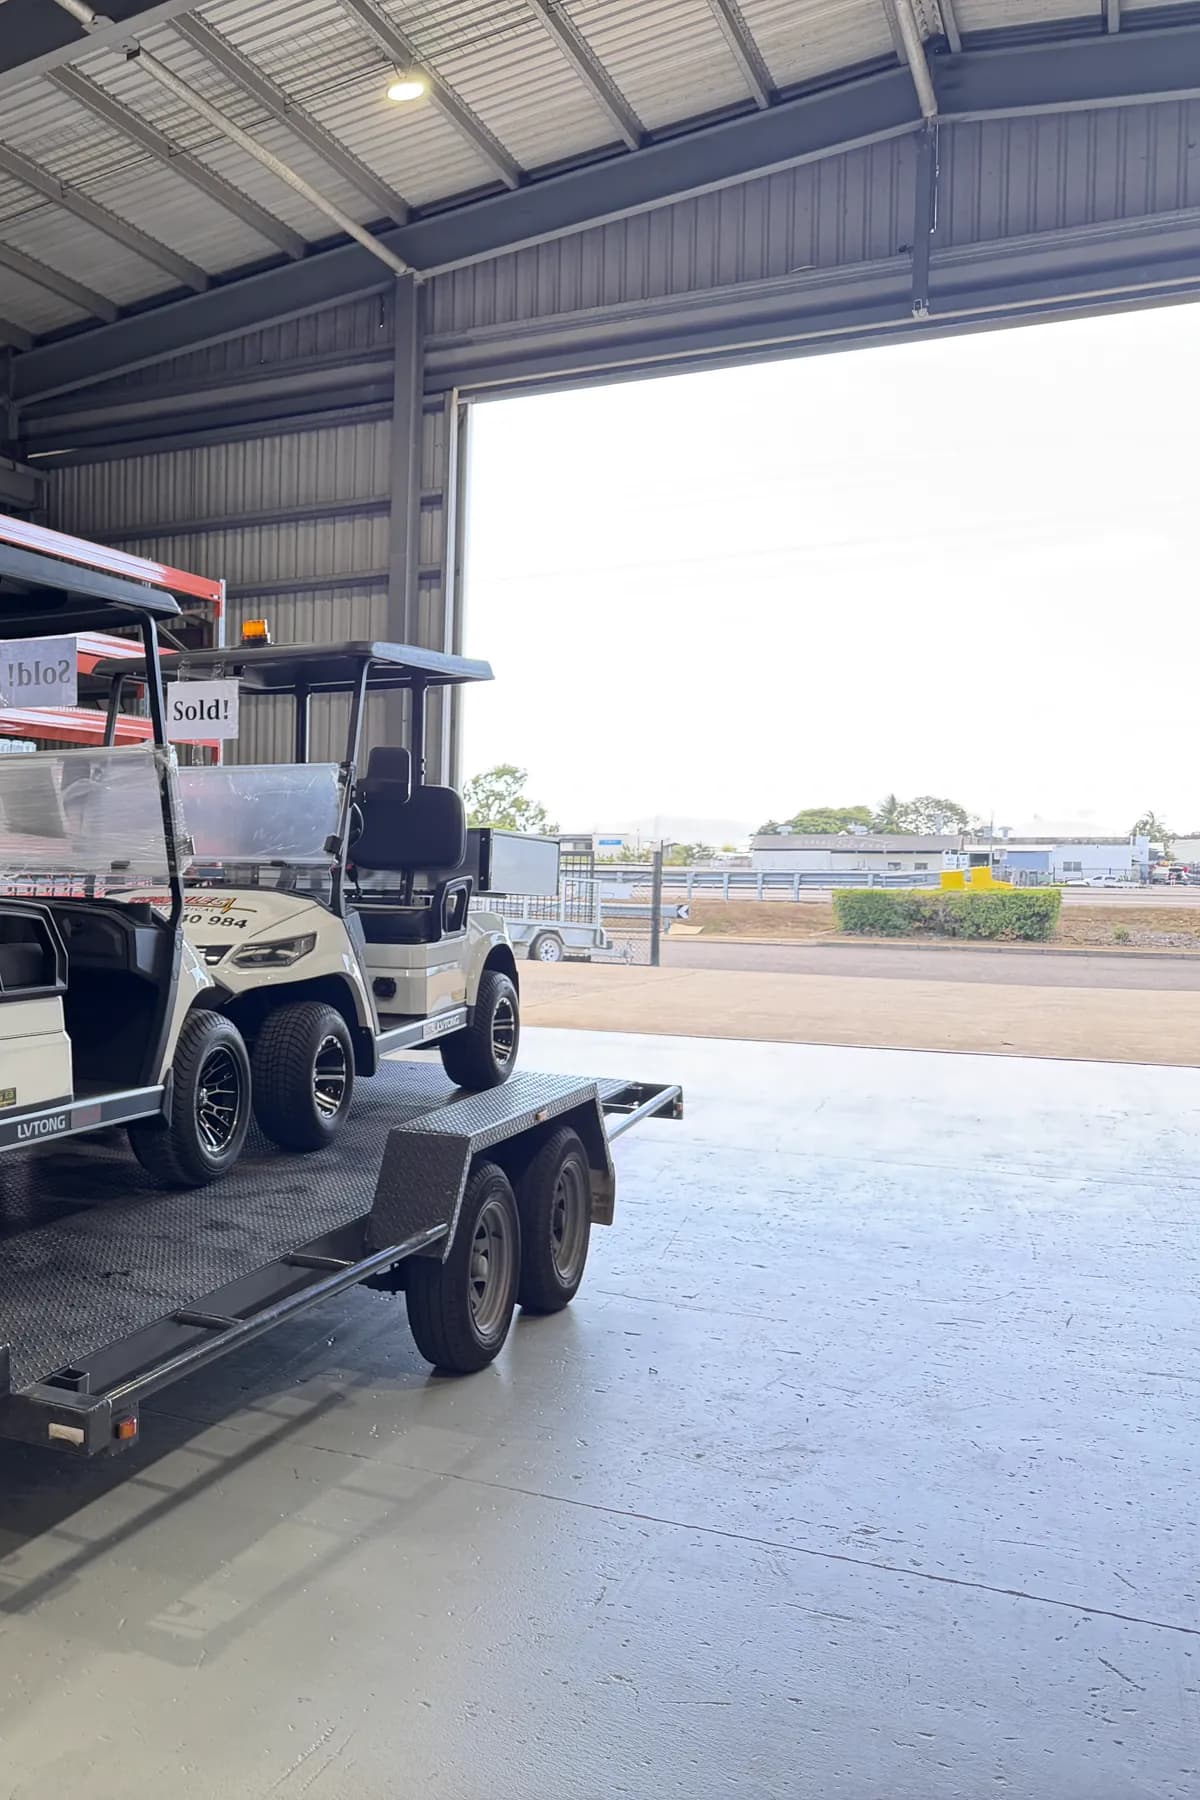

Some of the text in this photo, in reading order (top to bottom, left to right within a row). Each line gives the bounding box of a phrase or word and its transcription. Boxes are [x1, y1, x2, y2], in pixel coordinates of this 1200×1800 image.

[173, 699, 230, 721] Sold!
[207, 915, 248, 929] 984
[17, 1115, 66, 1139] LVTONG
